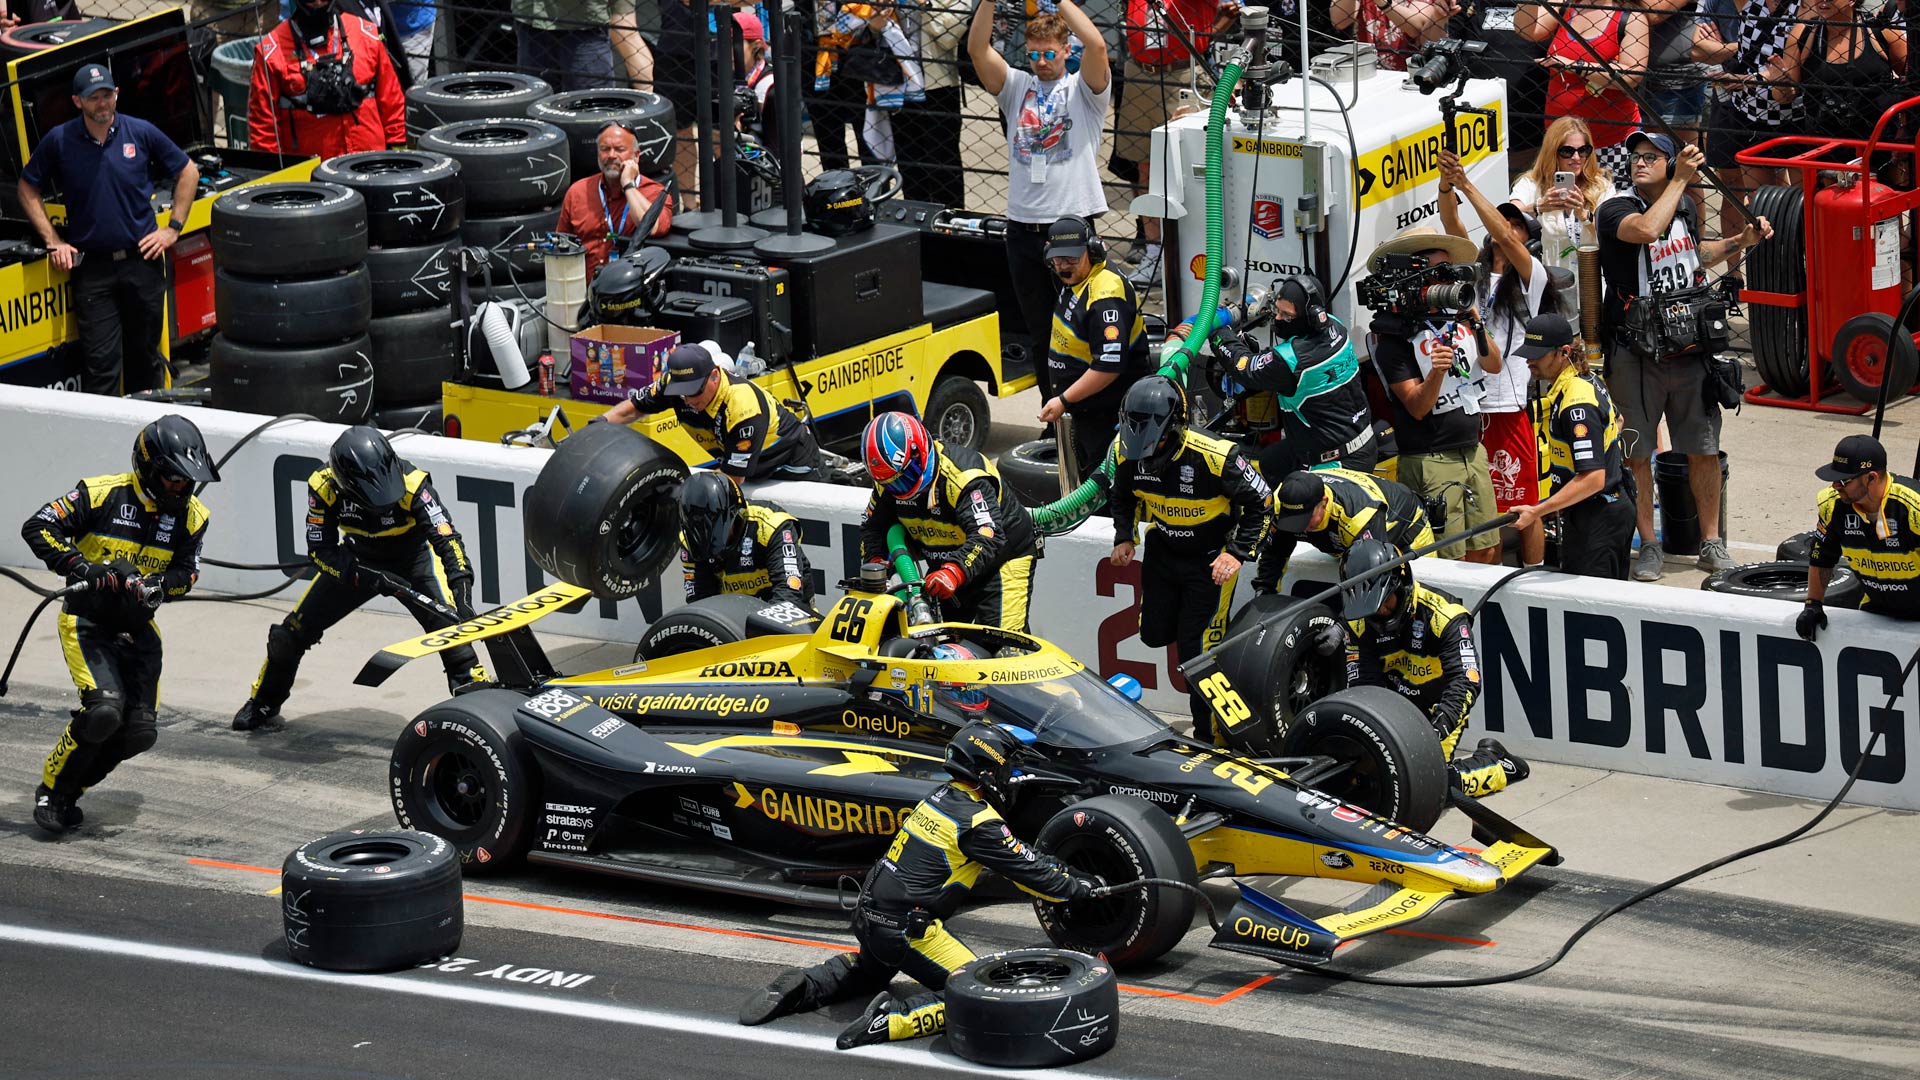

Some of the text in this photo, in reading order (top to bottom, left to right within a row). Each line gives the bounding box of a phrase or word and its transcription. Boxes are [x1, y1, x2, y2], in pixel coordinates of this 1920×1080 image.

[1245, 140, 1303, 157] GANBRIDGE
[818, 346, 905, 394] GAINBRIDGE
[656, 417, 682, 433] GROU
[1860, 461, 1873, 470] 26
[619, 468, 680, 508] FIREHAWK
[602, 573, 650, 594] Firestone
[420, 591, 575, 648] GROUP1001
[757, 601, 795, 617] GROUP
[765, 606, 812, 624] 1001
[829, 598, 874, 643] 26
[1308, 616, 1335, 628] FIREH
[649, 624, 724, 648] FIREHAWK
[698, 661, 795, 678] HONDA
[991, 665, 1064, 683] GAINBRIDGE
[524, 688, 564, 711] GROUP
[533, 693, 583, 718] 1001
[598, 692, 771, 717] visit gainbridge.io
[1198, 670, 1252, 729] 26
[590, 716, 622, 741] CURB
[842, 709, 911, 738] OneUp
[442, 720, 509, 783] FIREHAWK
[973, 737, 1006, 766] GAINBRIDGE
[1342, 713, 1398, 776] FIREHAWK
[657, 764, 697, 775] ZAPATA
[1109, 785, 1179, 805] ORTHOINDY
[494, 788, 509, 840] INDY500
[546, 814, 594, 829] stratasys
[761, 787, 913, 837] GAINBRIDG
[543, 841, 588, 852] Firestone
[1105, 825, 1150, 903] FIREHAK
[1336, 892, 1426, 932] GAINBRIDGE
[1126, 906, 1147, 948] INDY500
[1234, 916, 1311, 950] OneUp
[475, 963, 596, 989] INDY
